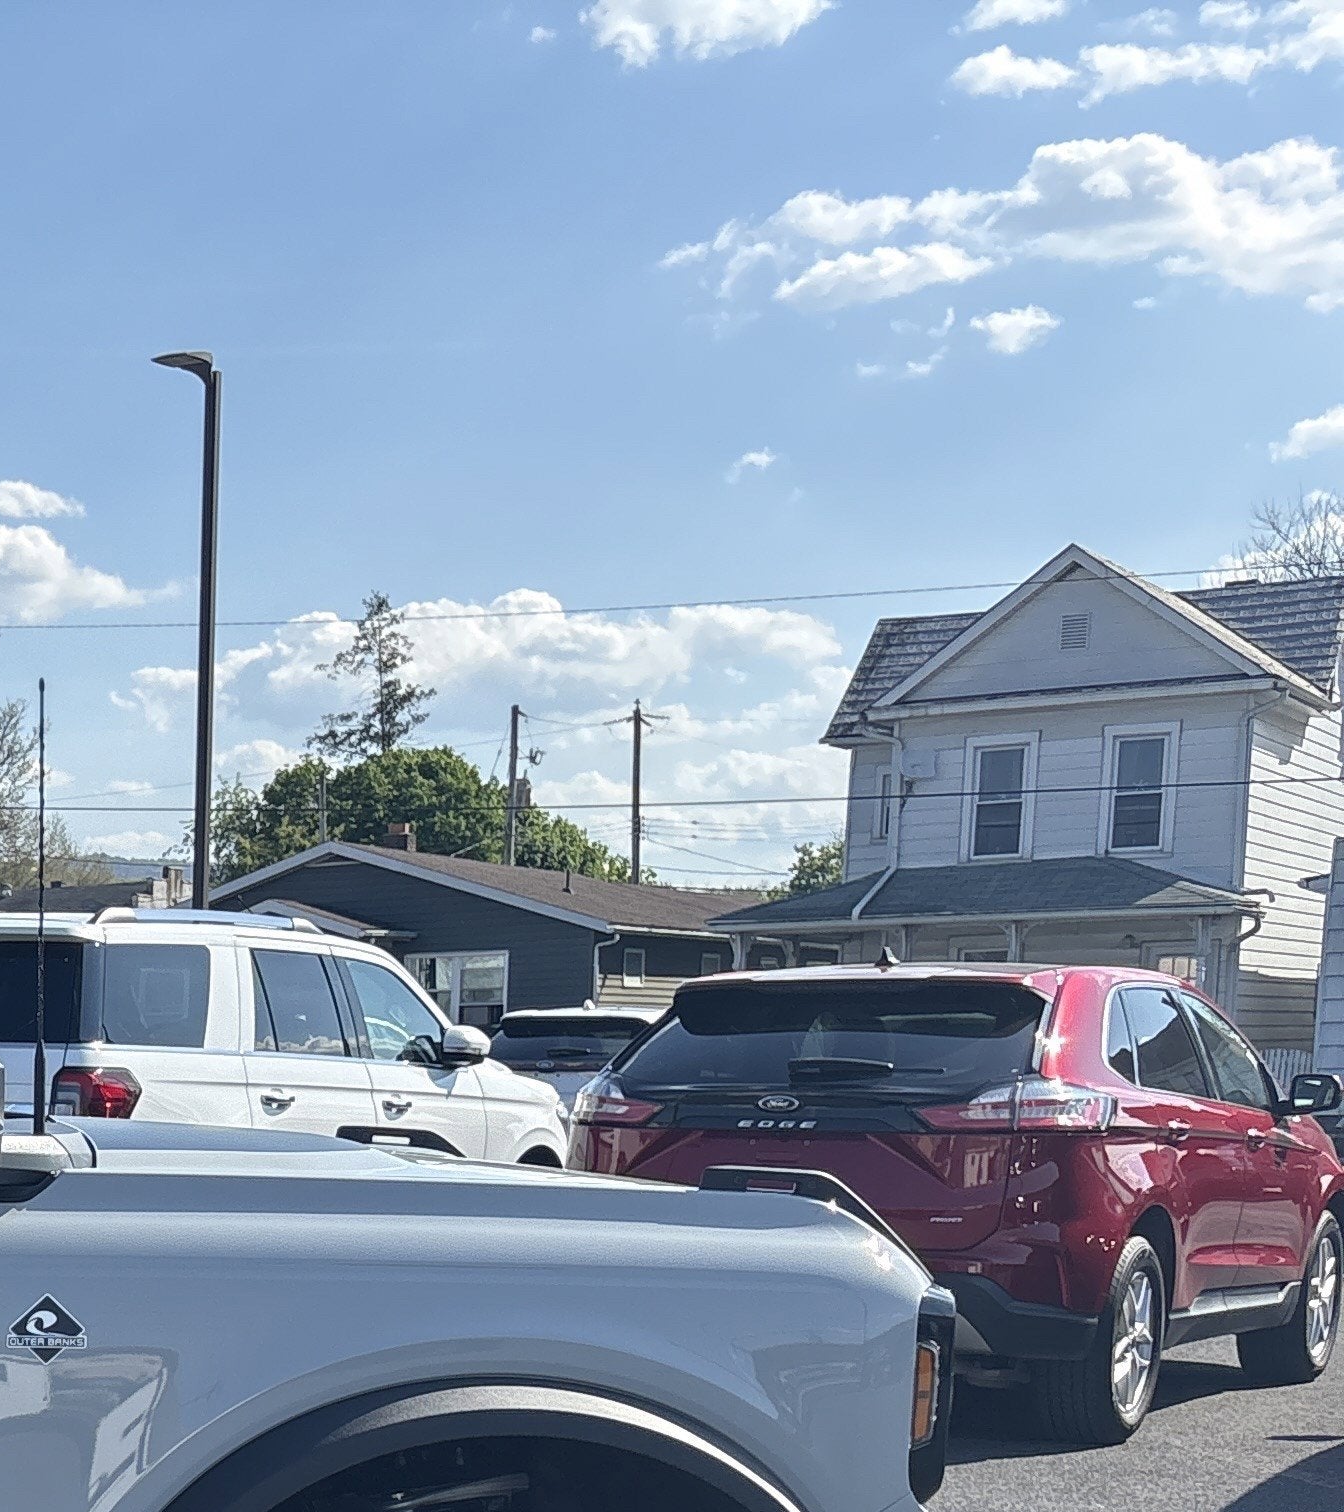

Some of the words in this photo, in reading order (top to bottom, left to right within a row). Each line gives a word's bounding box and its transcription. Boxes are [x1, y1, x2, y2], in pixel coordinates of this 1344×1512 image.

[737, 1119, 817, 1129] EDGE
[9, 1337, 46, 1347] OUTER
[47, 1338, 84, 1347] BANKS
